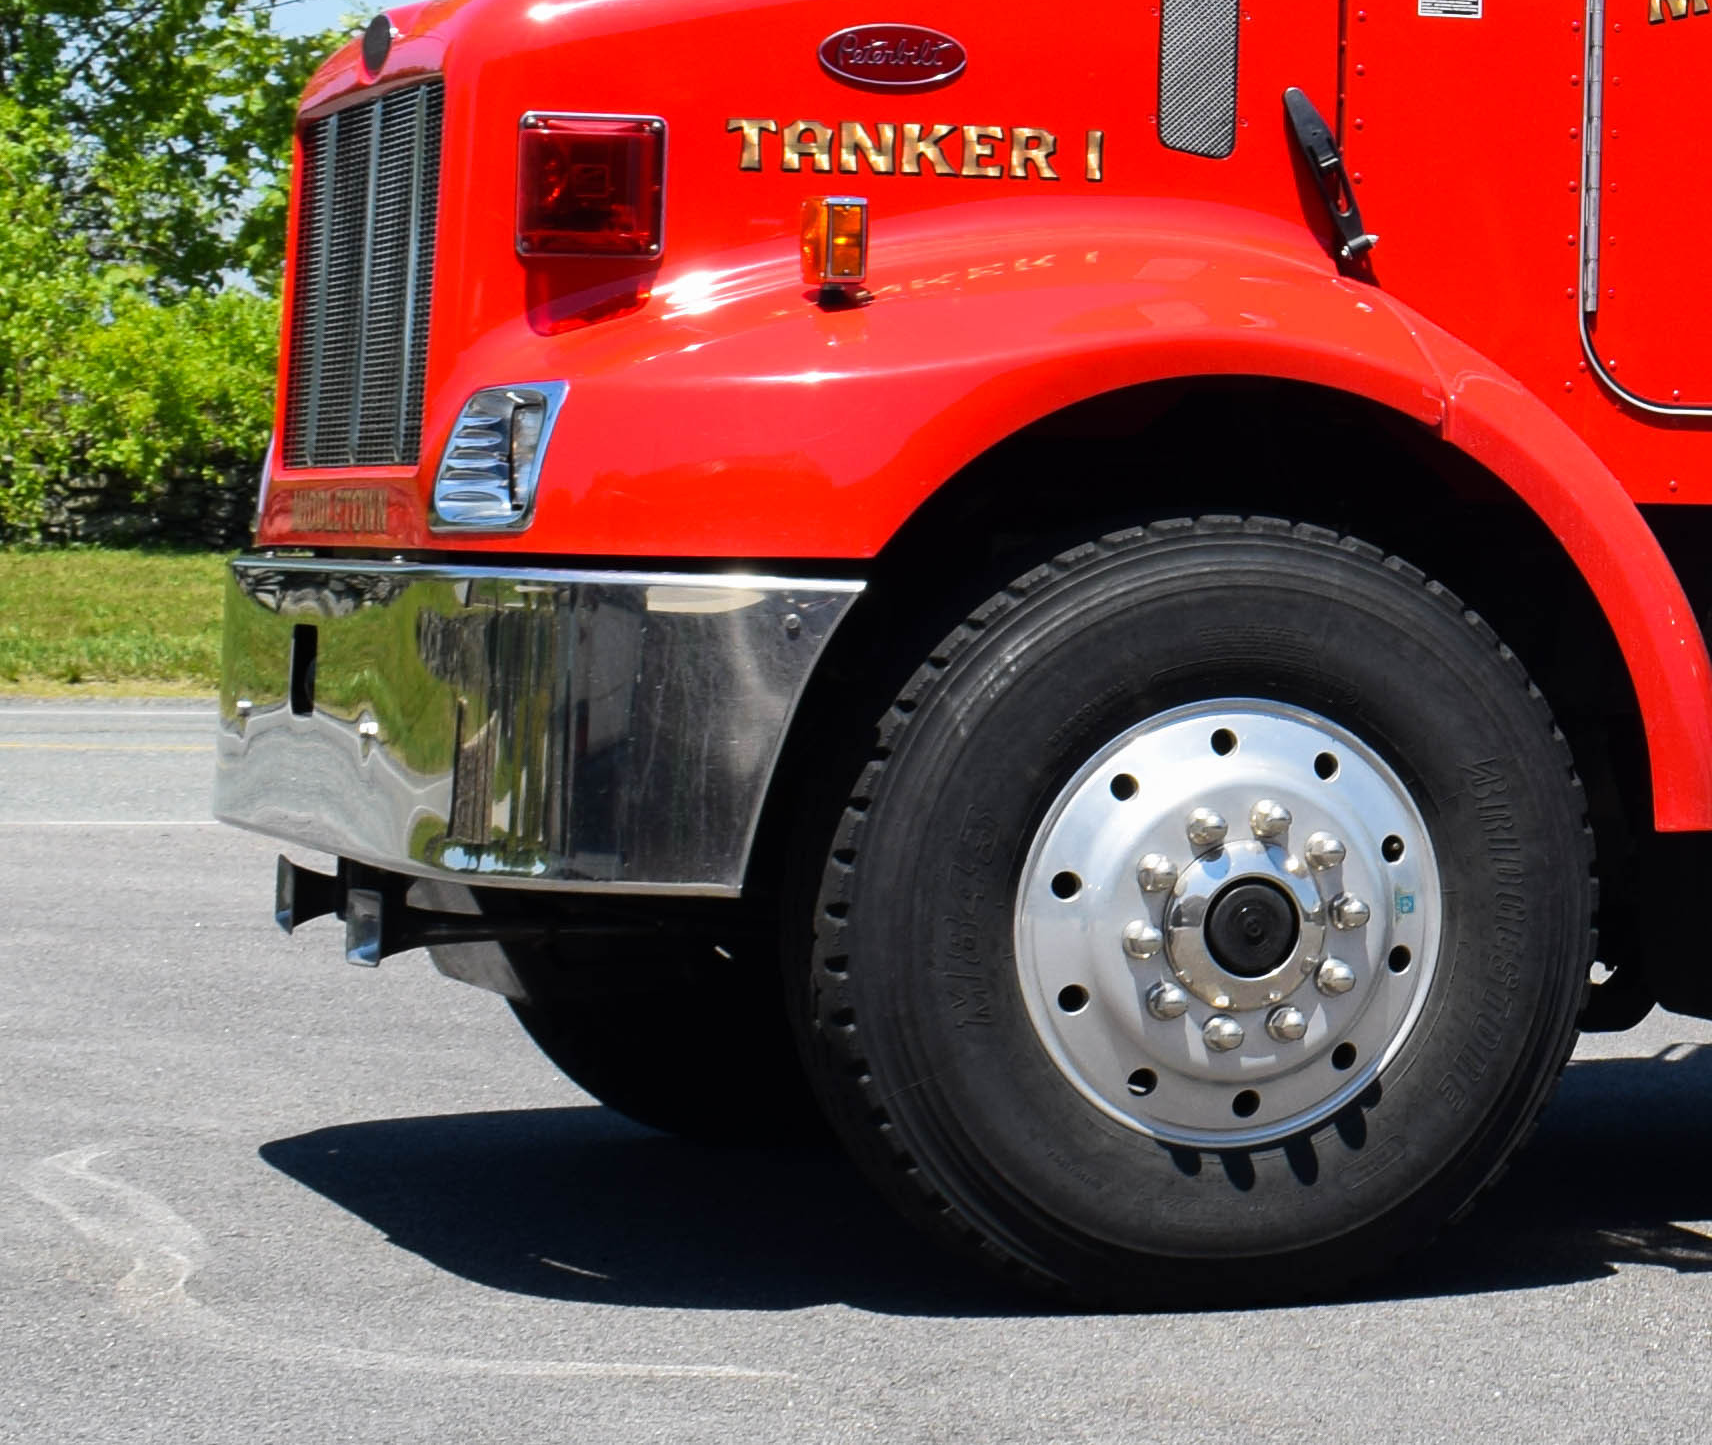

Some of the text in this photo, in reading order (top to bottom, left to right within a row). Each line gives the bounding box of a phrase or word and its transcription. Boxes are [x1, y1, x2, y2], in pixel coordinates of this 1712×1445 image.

[837, 33, 954, 66] Peterbilt
[726, 118, 1060, 181] TANKER
[292, 489, 389, 533] MIDDLETOWN
[1436, 754, 1530, 1113] BRIDGESTONE
